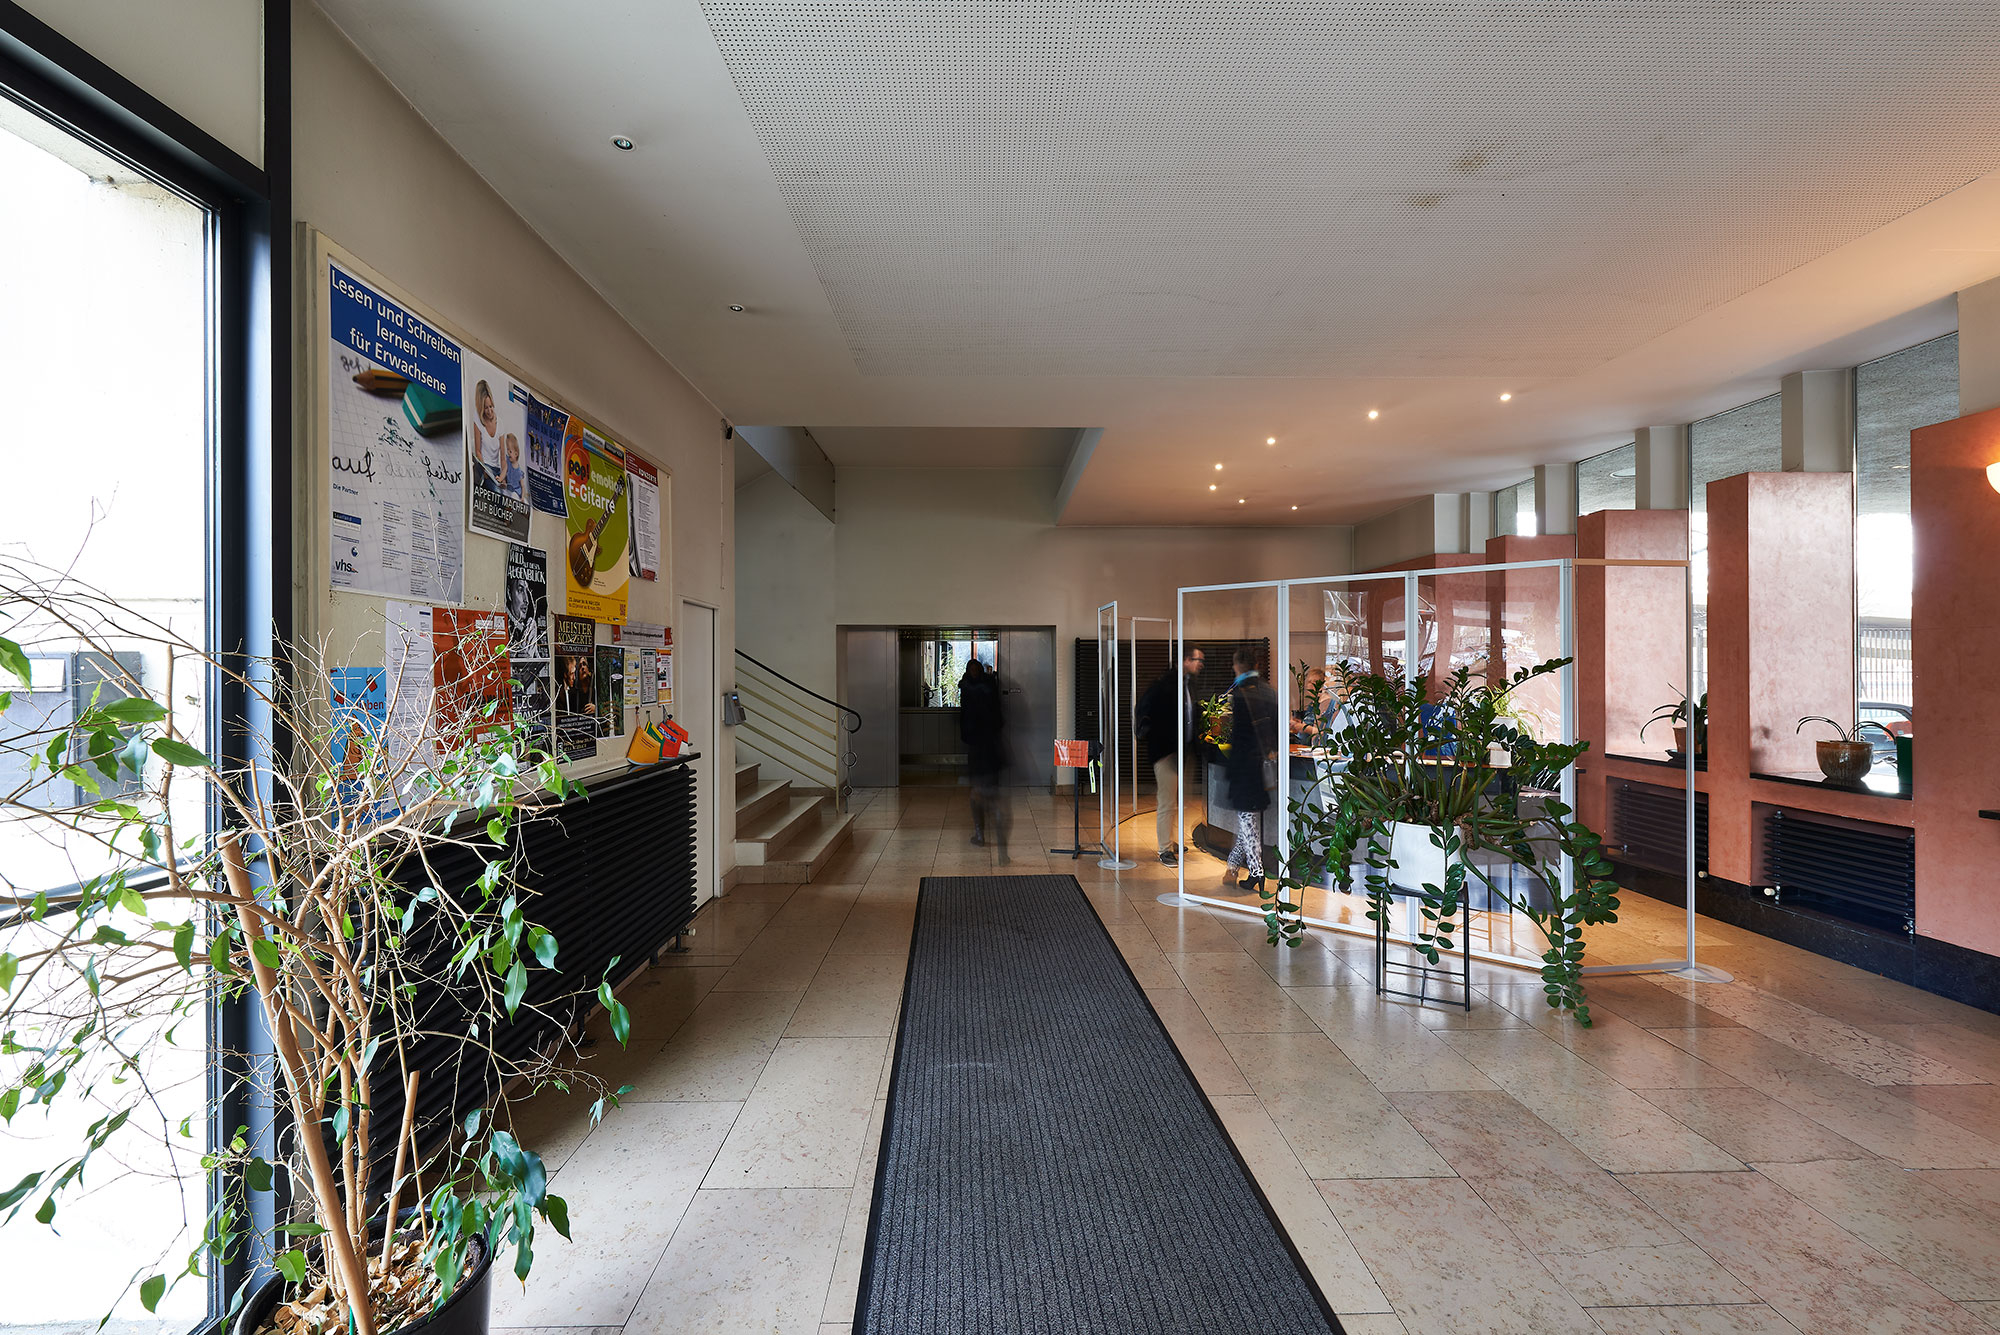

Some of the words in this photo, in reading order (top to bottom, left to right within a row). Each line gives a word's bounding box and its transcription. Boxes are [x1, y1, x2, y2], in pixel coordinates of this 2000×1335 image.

[332, 269, 373, 310] Lesen
[377, 302, 404, 328] und
[407, 318, 460, 364] Schreiben
[376, 319, 418, 358] lernen
[349, 327, 371, 353] für
[375, 341, 447, 394] Erwachsene
[332, 447, 375, 482] auf
[568, 459, 590, 481] pop!
[332, 483, 342, 491] Die
[342, 485, 359, 496] Partner
[591, 470, 624, 495] emotio
[474, 485, 501, 504] APPETIT
[501, 496, 529, 515] MACHEN
[568, 478, 616, 514] E-Gitarre
[473, 499, 488, 512] AUF
[488, 504, 514, 522] BÜCHER
[334, 559, 353, 573] vhs
[507, 565, 546, 585] AUGENBLICK
[558, 620, 592, 636] MEISTER
[558, 632, 593, 646] KONZERTE
